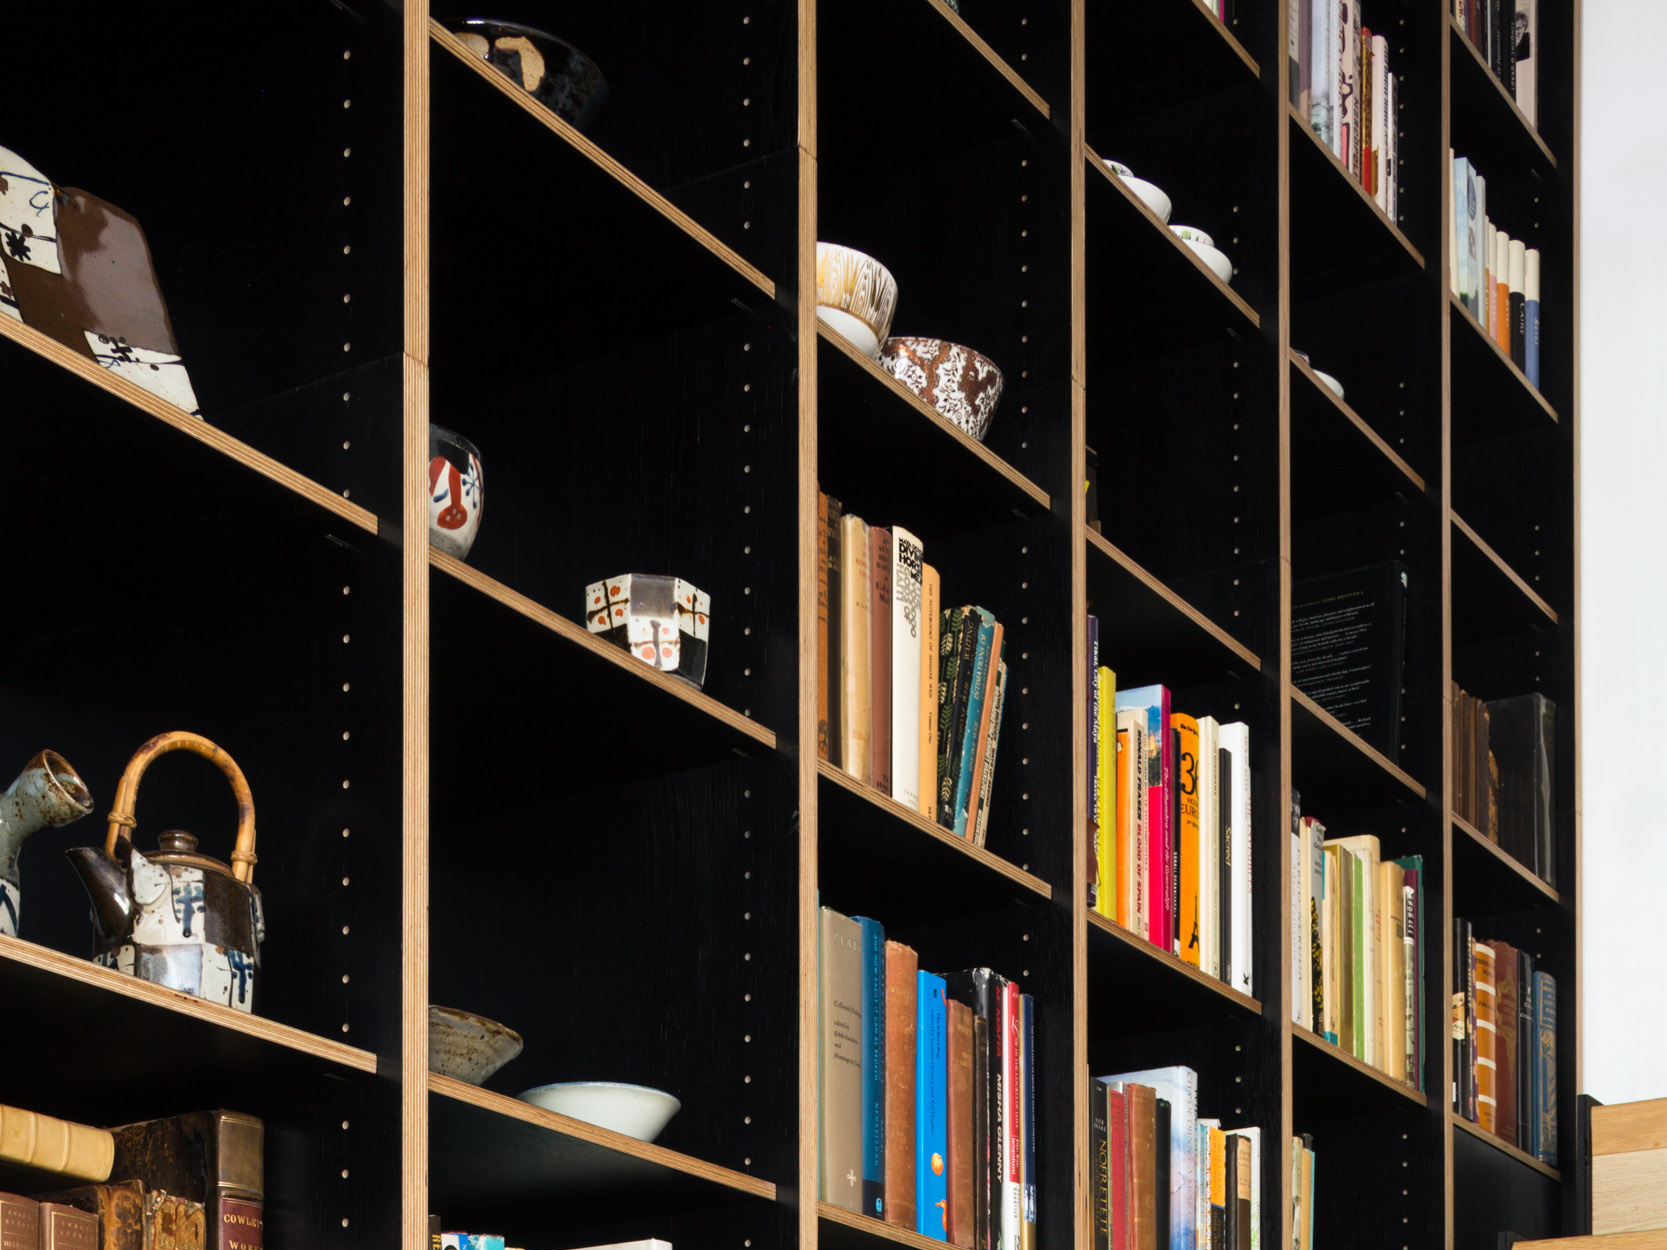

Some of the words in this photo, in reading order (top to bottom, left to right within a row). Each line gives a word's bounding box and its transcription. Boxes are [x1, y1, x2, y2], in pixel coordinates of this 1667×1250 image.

[963, 620, 974, 661] WAITING
[973, 647, 985, 701] INTIMATIONS
[1224, 826, 1232, 867] Sacred
[1137, 863, 1142, 876] OF
[874, 1006, 879, 1014] IT
[874, 1036, 879, 1046] BE
[1099, 1139, 1108, 1238] NOFRETETE
